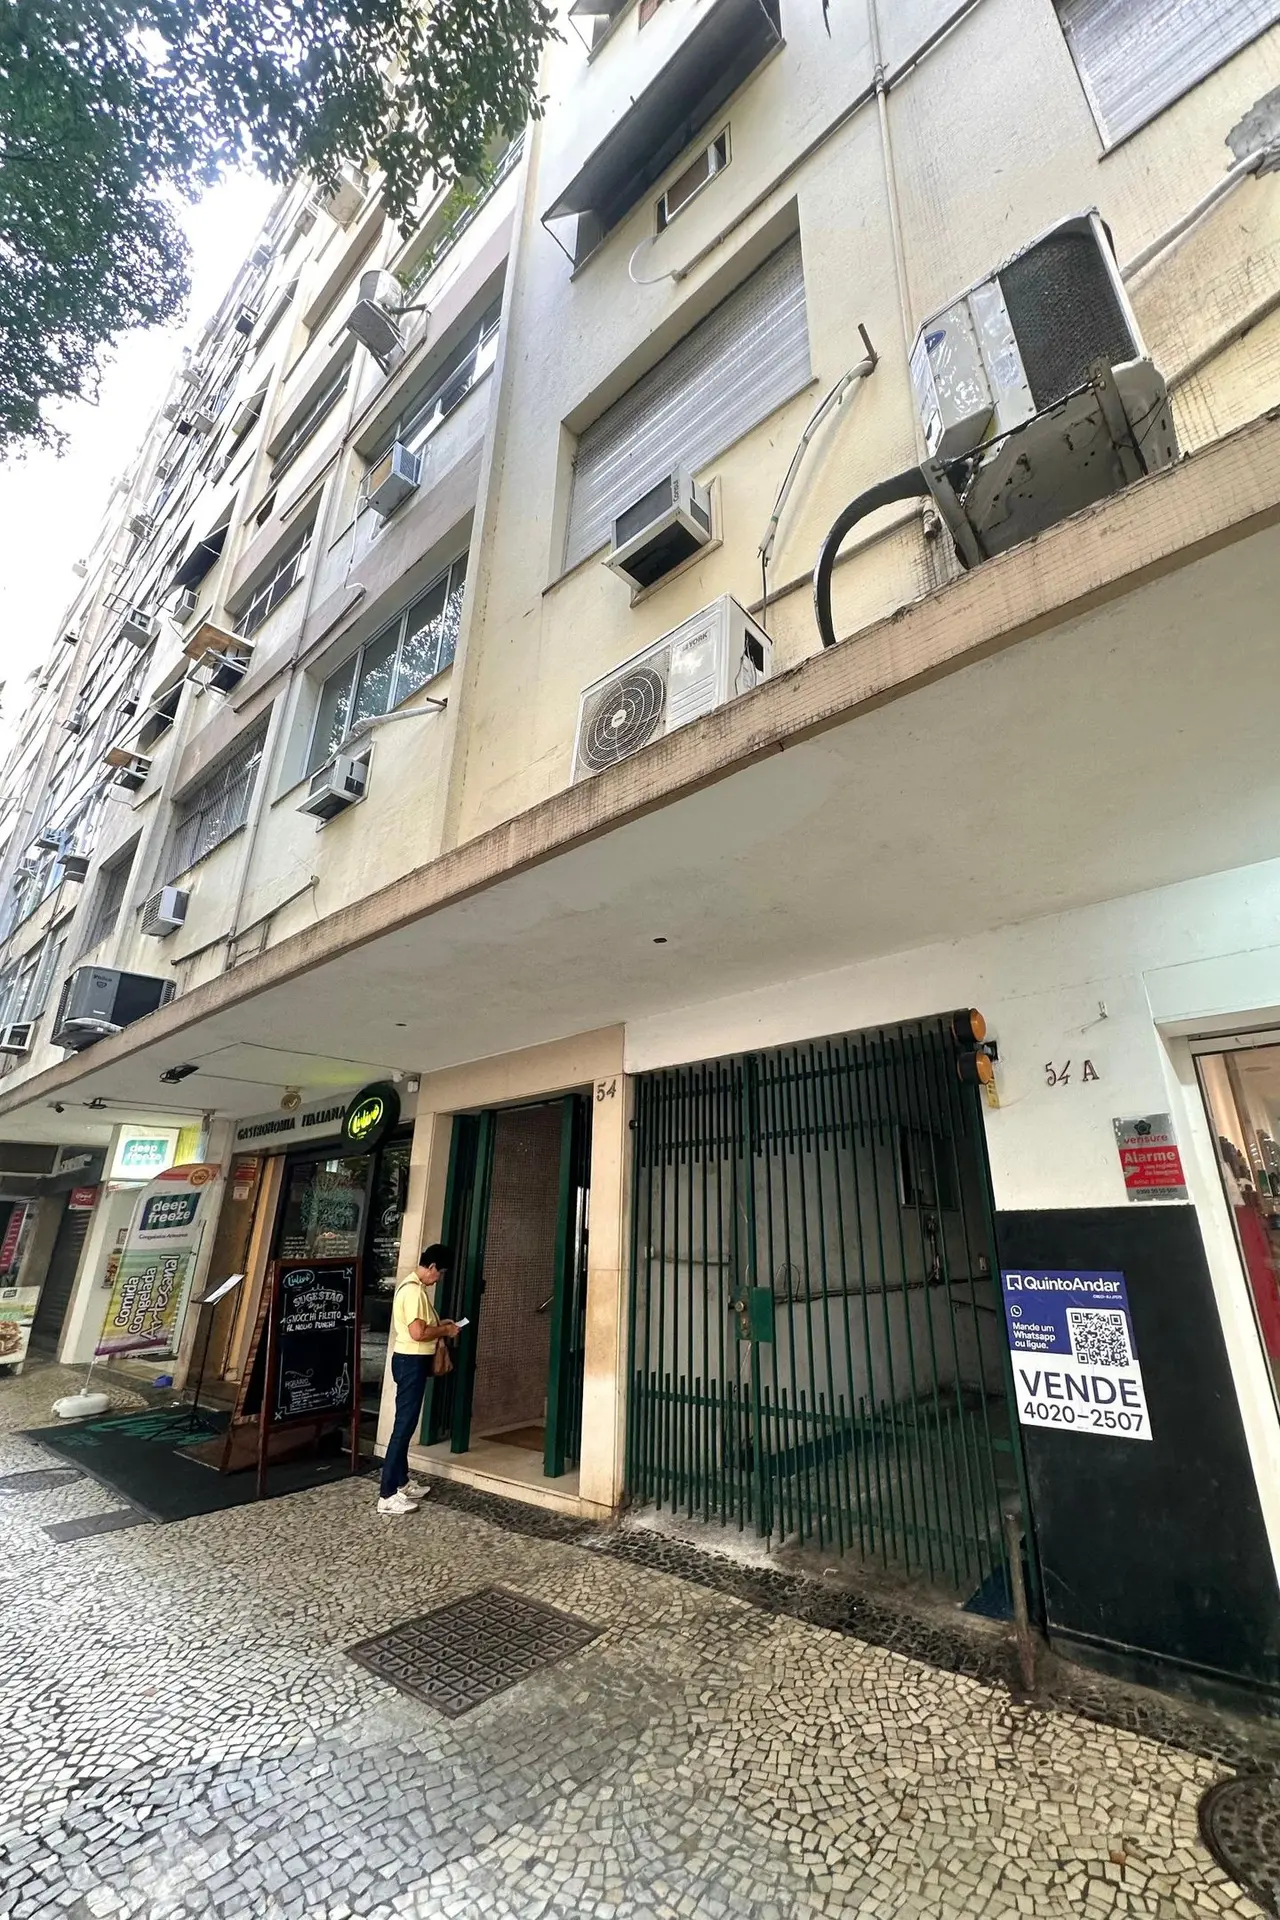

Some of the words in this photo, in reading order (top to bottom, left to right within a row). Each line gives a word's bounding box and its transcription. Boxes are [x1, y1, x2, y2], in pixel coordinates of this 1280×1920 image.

[1045, 1060, 1070, 1087] 54
[1082, 1059, 1100, 1082] A
[596, 1079, 617, 1102] 54
[237, 1117, 296, 1140] GASTRONOMIA
[301, 1105, 346, 1127] ITALIANA
[130, 1142, 158, 1155] deep
[1124, 1151, 1176, 1164] Alarme
[148, 1209, 191, 1223] freeze
[152, 1200, 188, 1214] deep
[1024, 1276, 1120, 1292] QuintoAndar
[115, 1277, 139, 1327] Comida
[129, 1267, 157, 1333] Congelada
[141, 1255, 180, 1341] Artesanal
[1012, 1321, 1040, 1332] Mande
[1013, 1330, 1056, 1343] Whatsapp
[1026, 1340, 1049, 1350] ligue.
[1019, 1369, 1142, 1408] VENDE
[1024, 1401, 1143, 1432] 4020-2507
